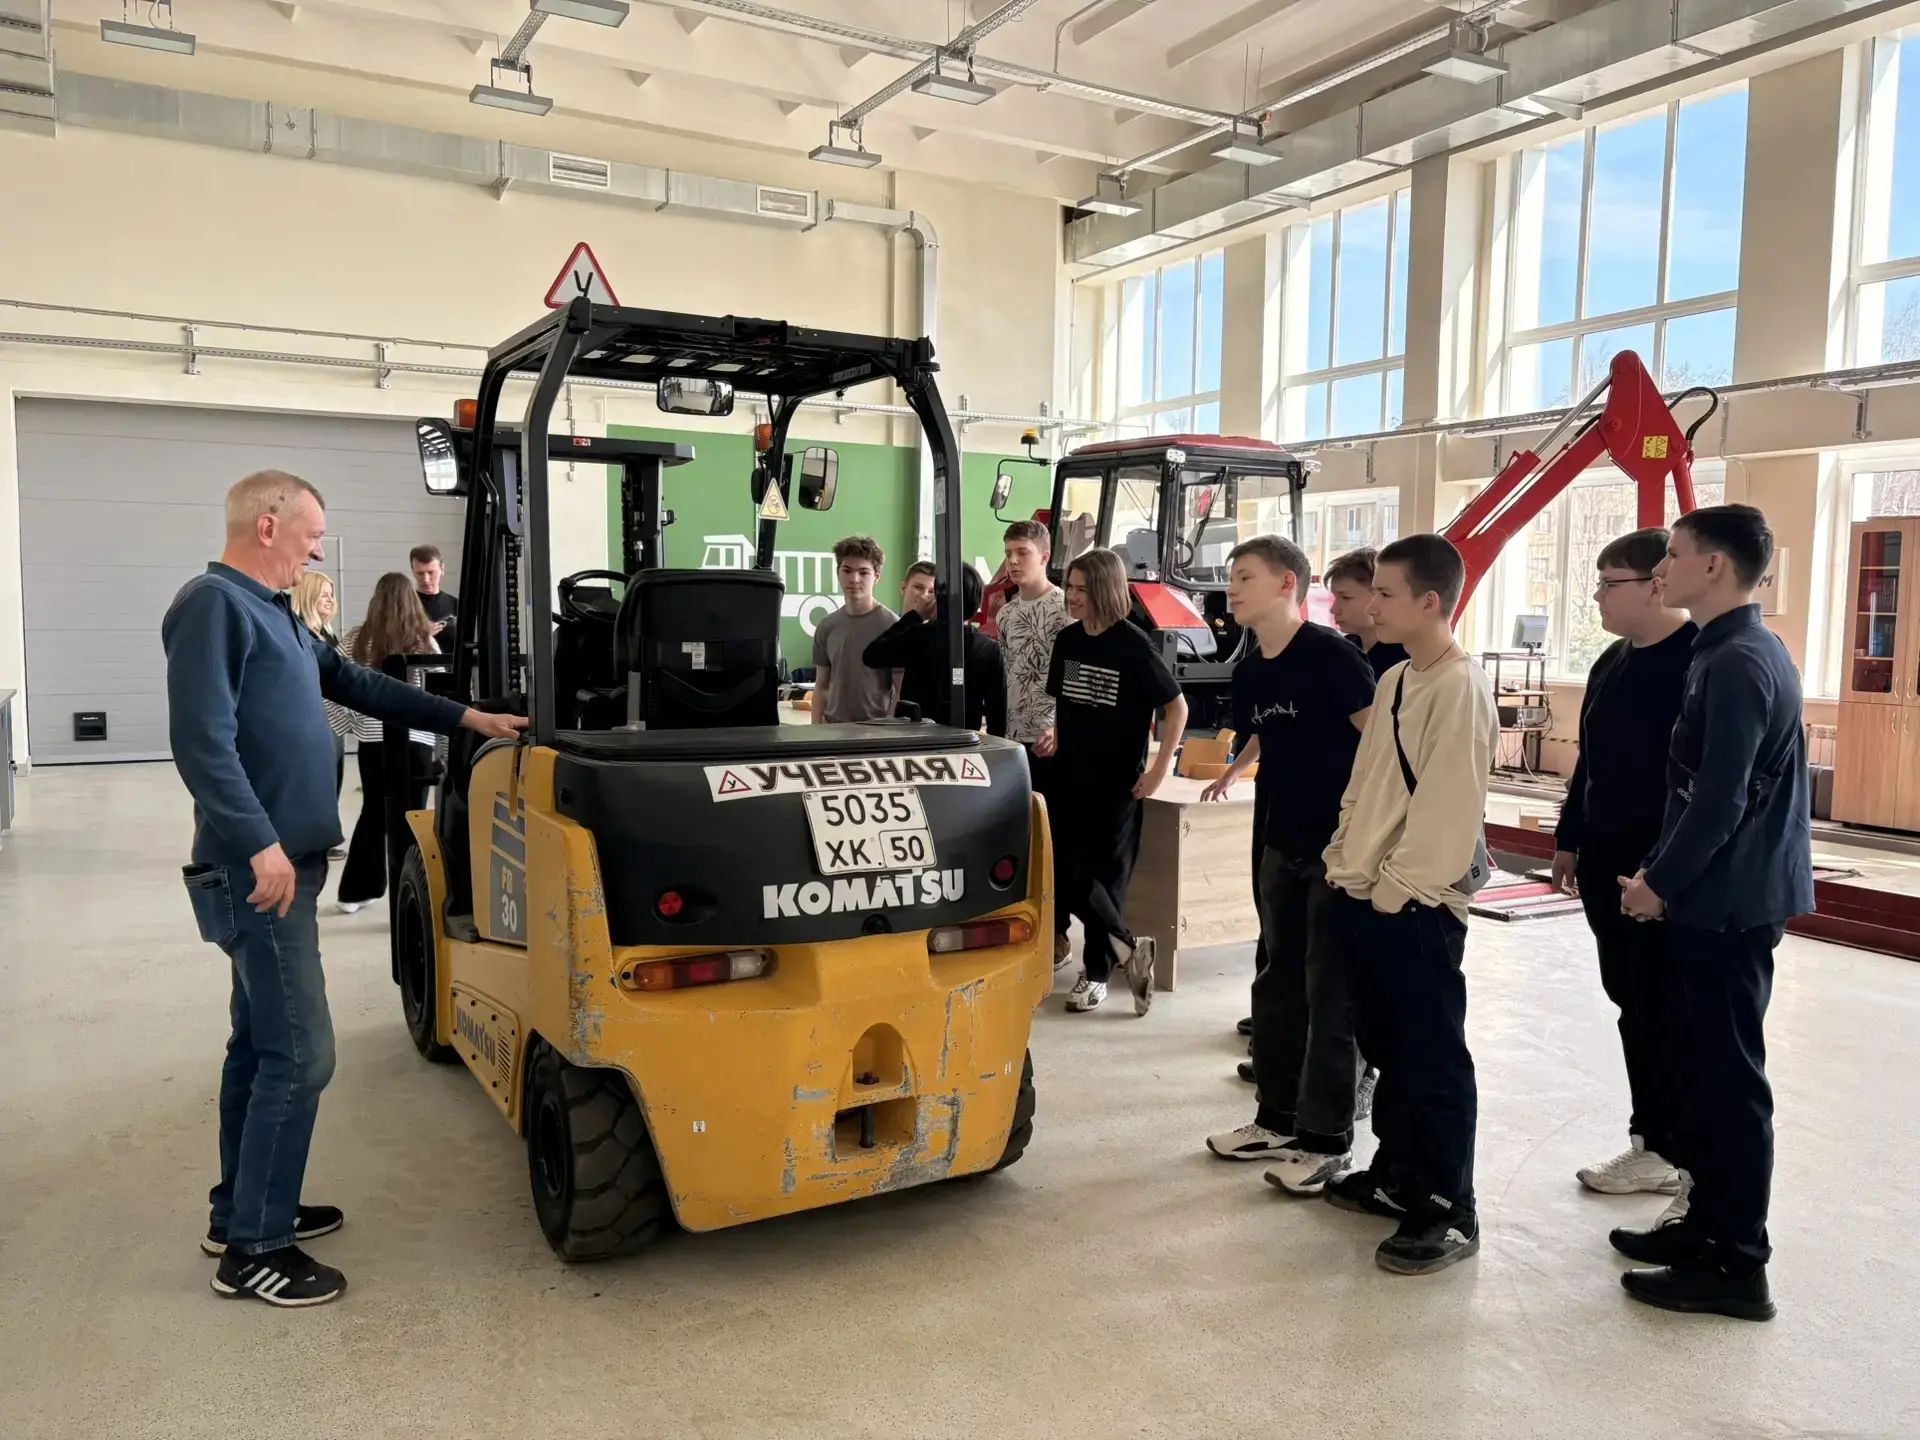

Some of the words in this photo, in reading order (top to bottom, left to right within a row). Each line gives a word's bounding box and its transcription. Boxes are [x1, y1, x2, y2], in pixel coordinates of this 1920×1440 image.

[749, 757, 959, 792] УЧЕБНАЯ
[821, 792, 911, 826] 5035
[825, 838, 872, 868] ХК
[890, 835, 925, 862] 50
[762, 867, 965, 919] KOMATSU
[502, 894, 517, 932] 30
[457, 1004, 496, 1067] KOMATSU
[1430, 1194, 1452, 1209] PUMA
